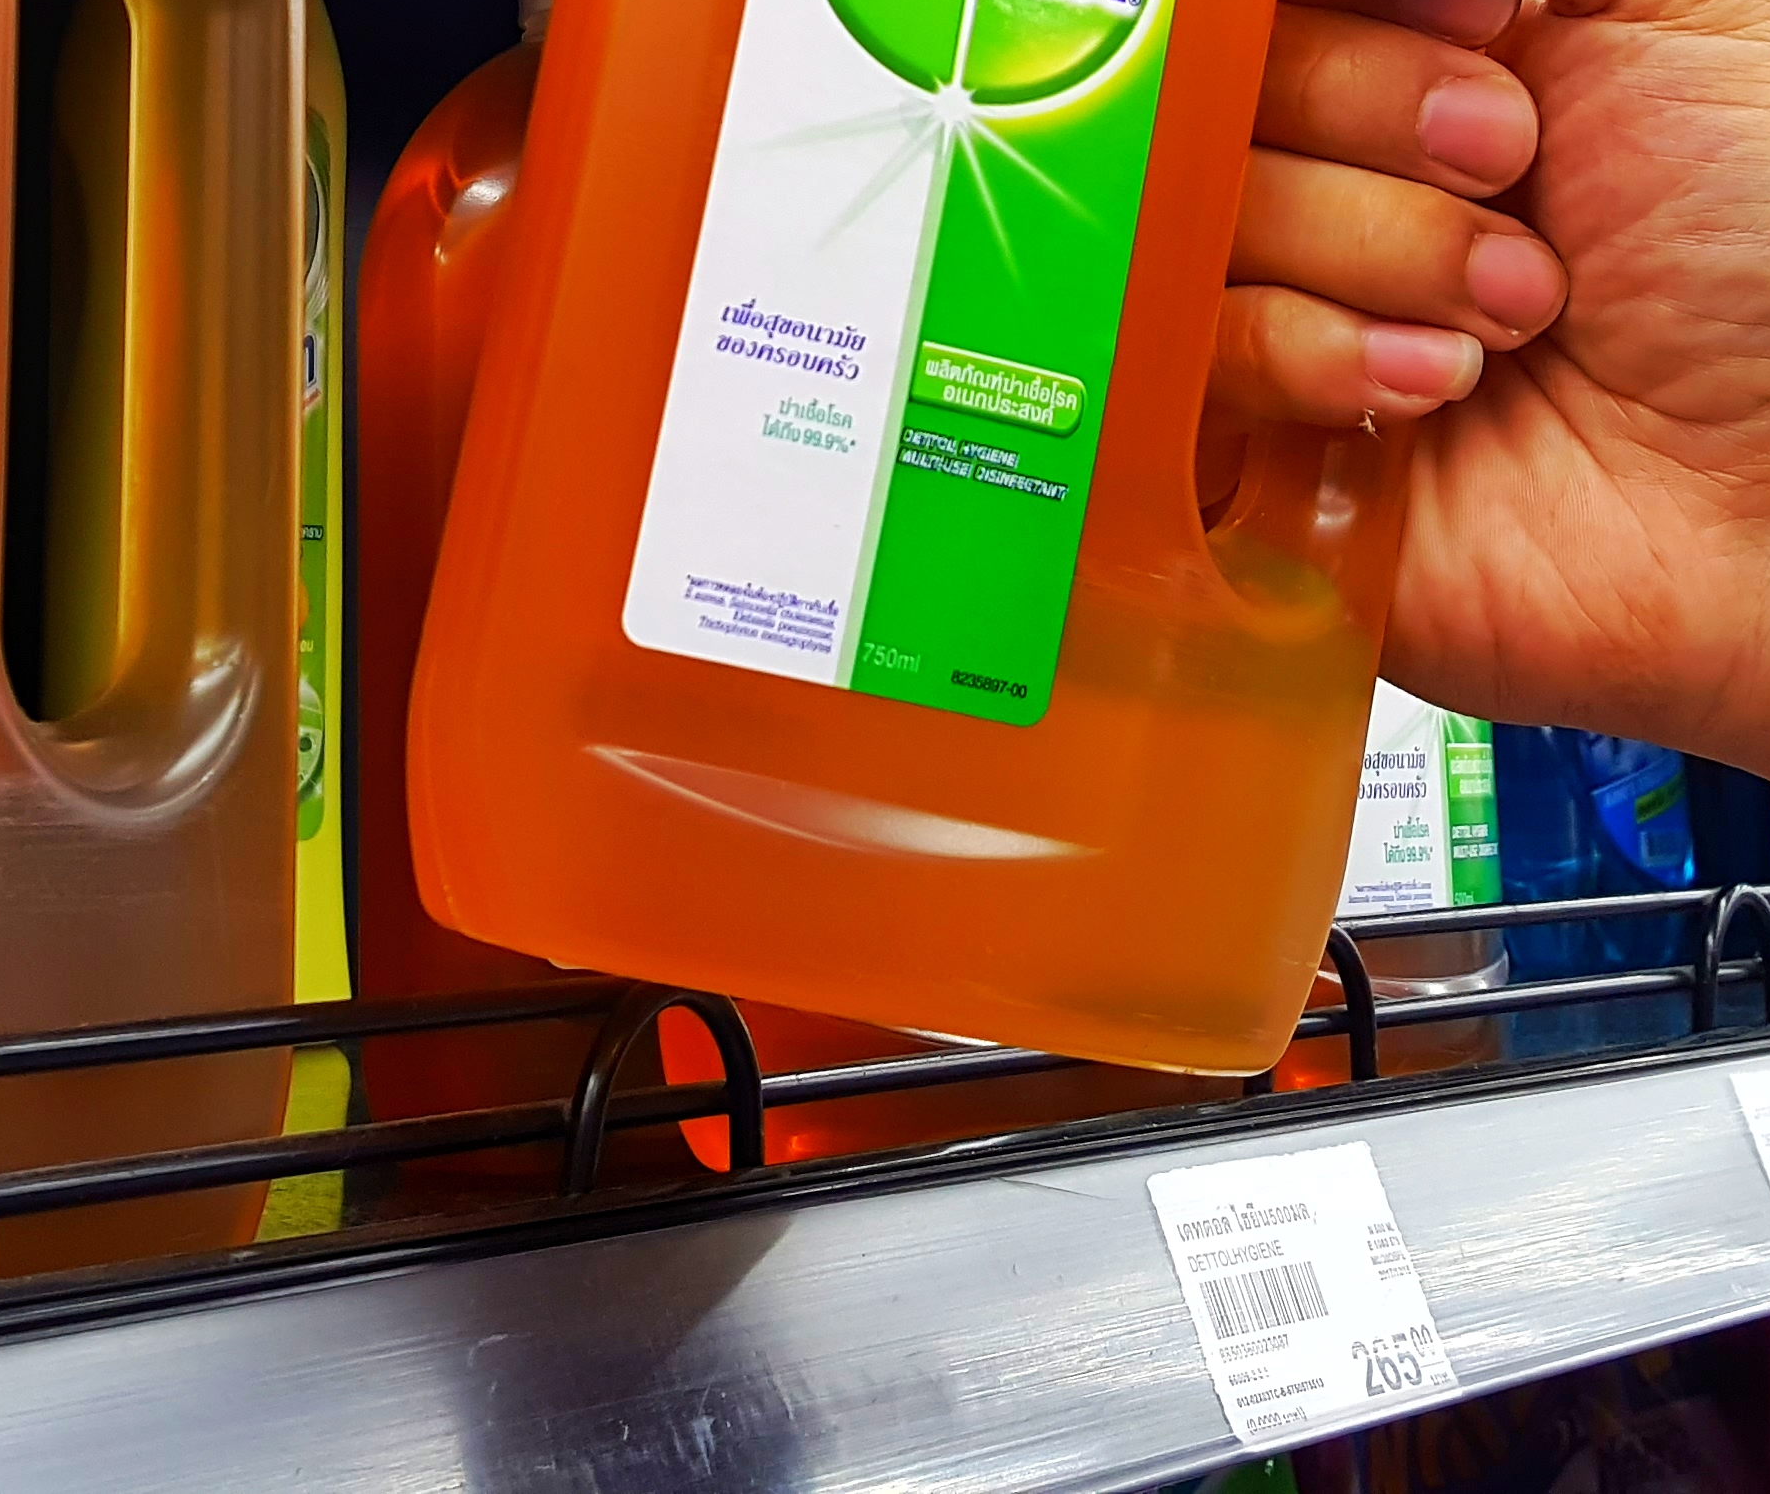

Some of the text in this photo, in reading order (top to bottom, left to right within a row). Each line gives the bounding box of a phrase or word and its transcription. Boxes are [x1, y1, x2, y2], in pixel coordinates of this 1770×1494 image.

[720, 298, 867, 352] เพื่อสุขอนามัย
[716, 334, 860, 381] ของครอบครัว
[862, 641, 921, 673] 750ml
[1364, 746, 1426, 777] อสุขอนามัย
[1359, 776, 1428, 800] องครอบครัว
[1351, 1332, 1423, 1398] 265
